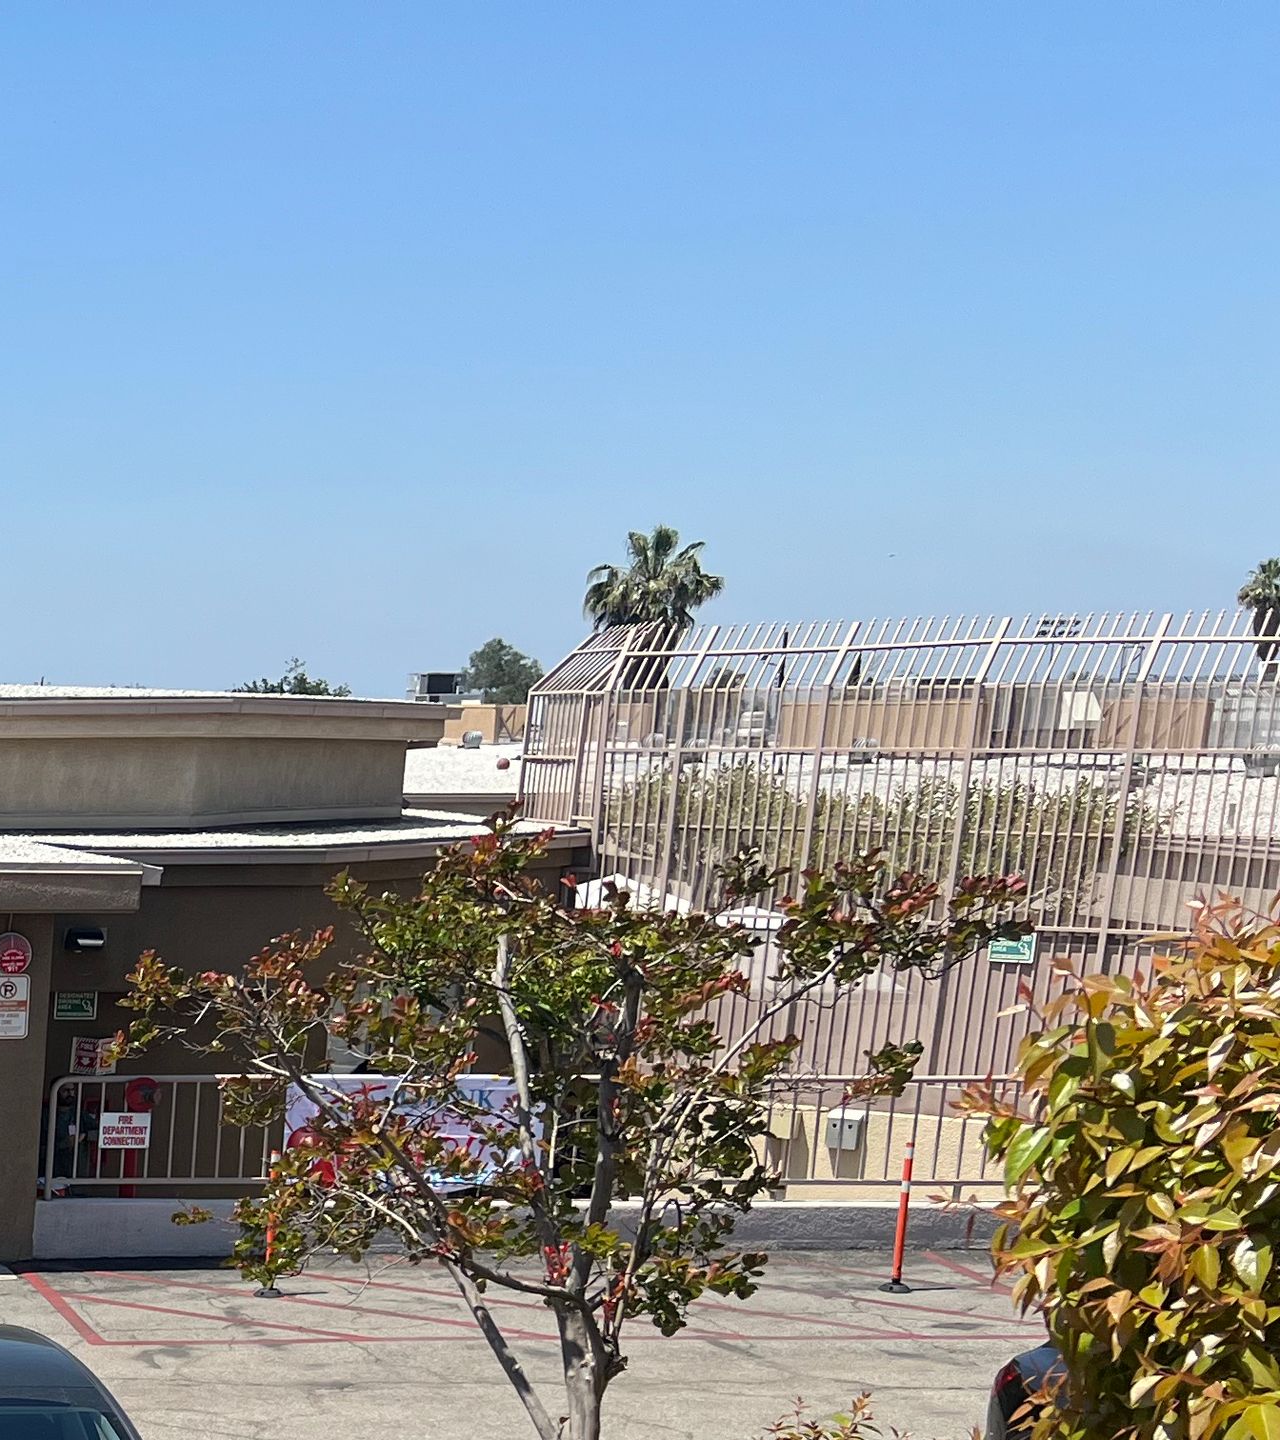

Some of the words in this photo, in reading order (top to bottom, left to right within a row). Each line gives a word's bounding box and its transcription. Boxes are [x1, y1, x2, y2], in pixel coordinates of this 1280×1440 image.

[118, 1115, 134, 1124] FIRE
[102, 1126, 148, 1135] DEPARTMENT
[102, 1136, 146, 1146] CONNECTION
